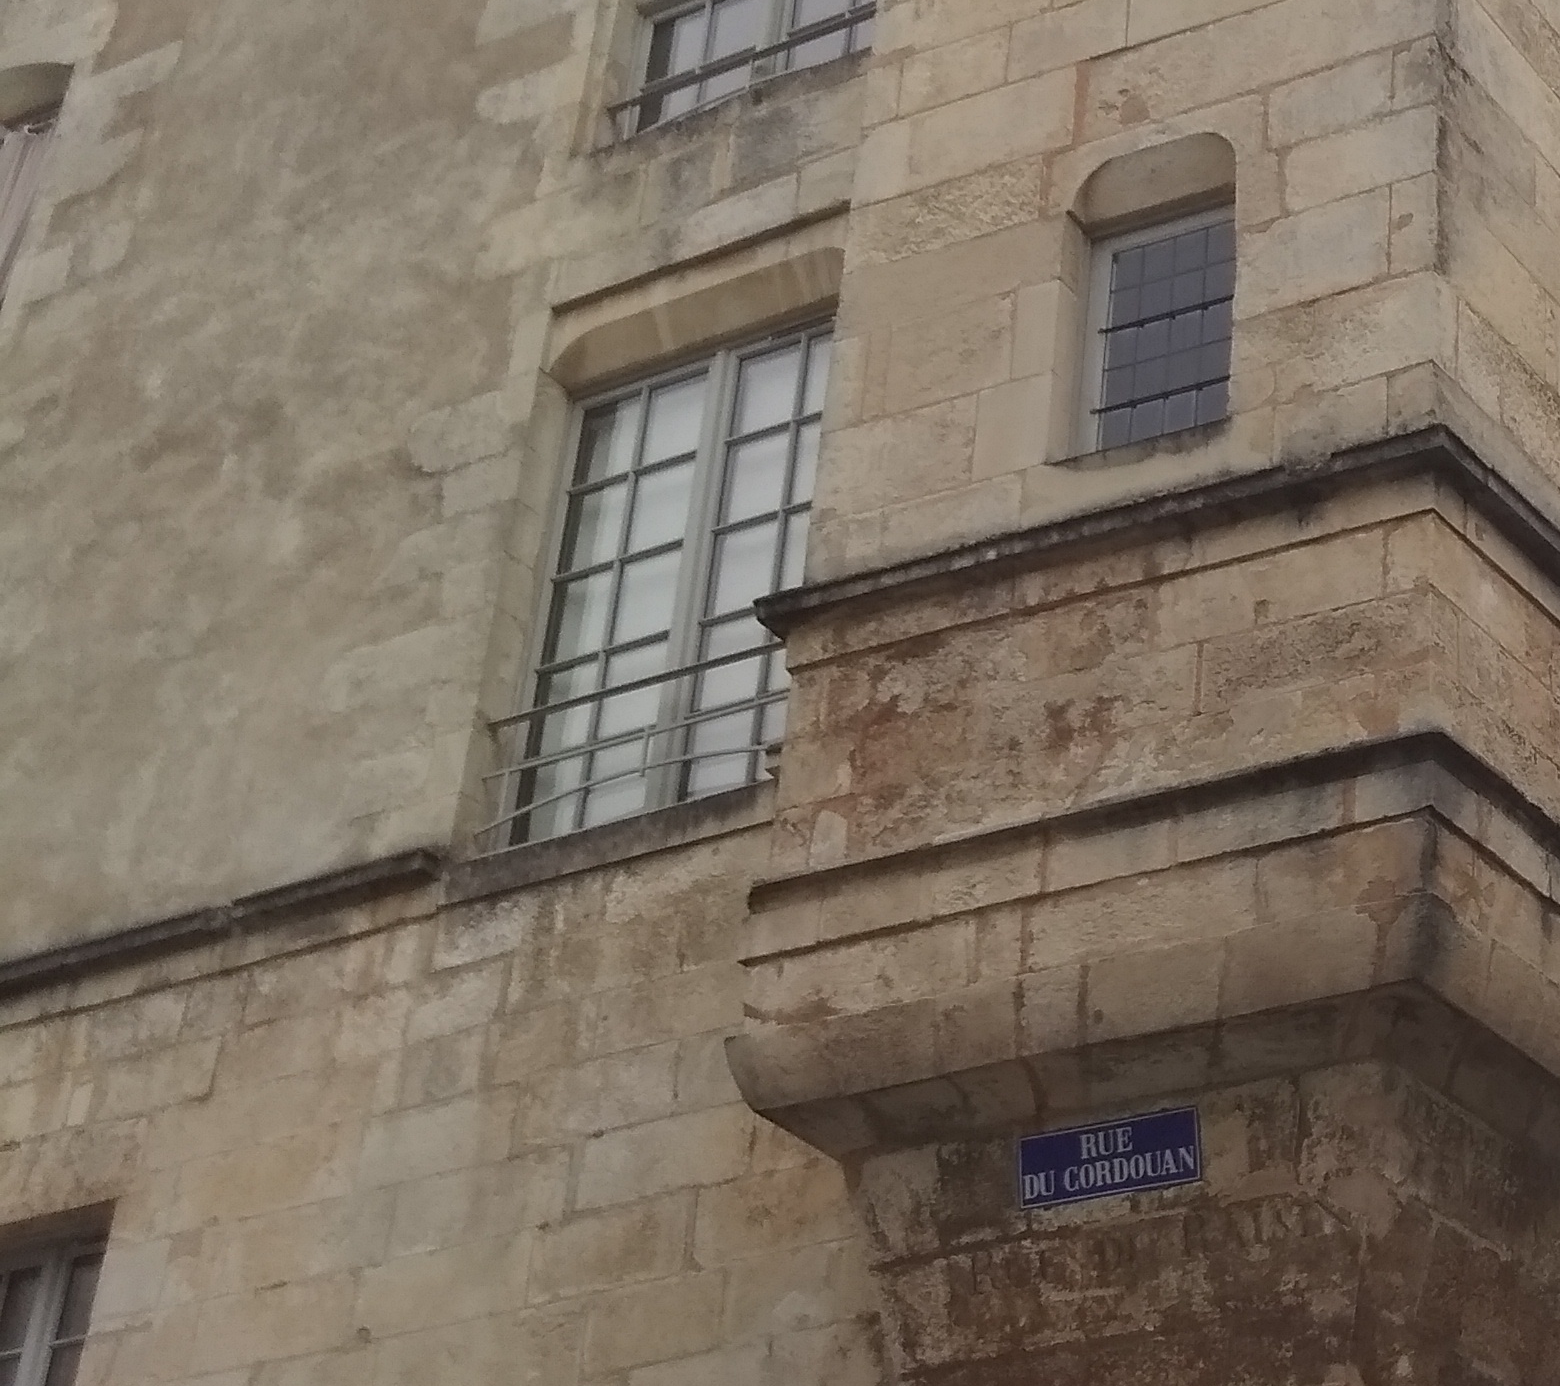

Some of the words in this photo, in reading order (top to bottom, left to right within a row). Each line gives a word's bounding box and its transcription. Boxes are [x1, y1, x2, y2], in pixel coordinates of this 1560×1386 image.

[1079, 1126, 1133, 1160] RUE
[1023, 1170, 1056, 1200] DU
[1063, 1145, 1195, 1192] CORDOUAN
